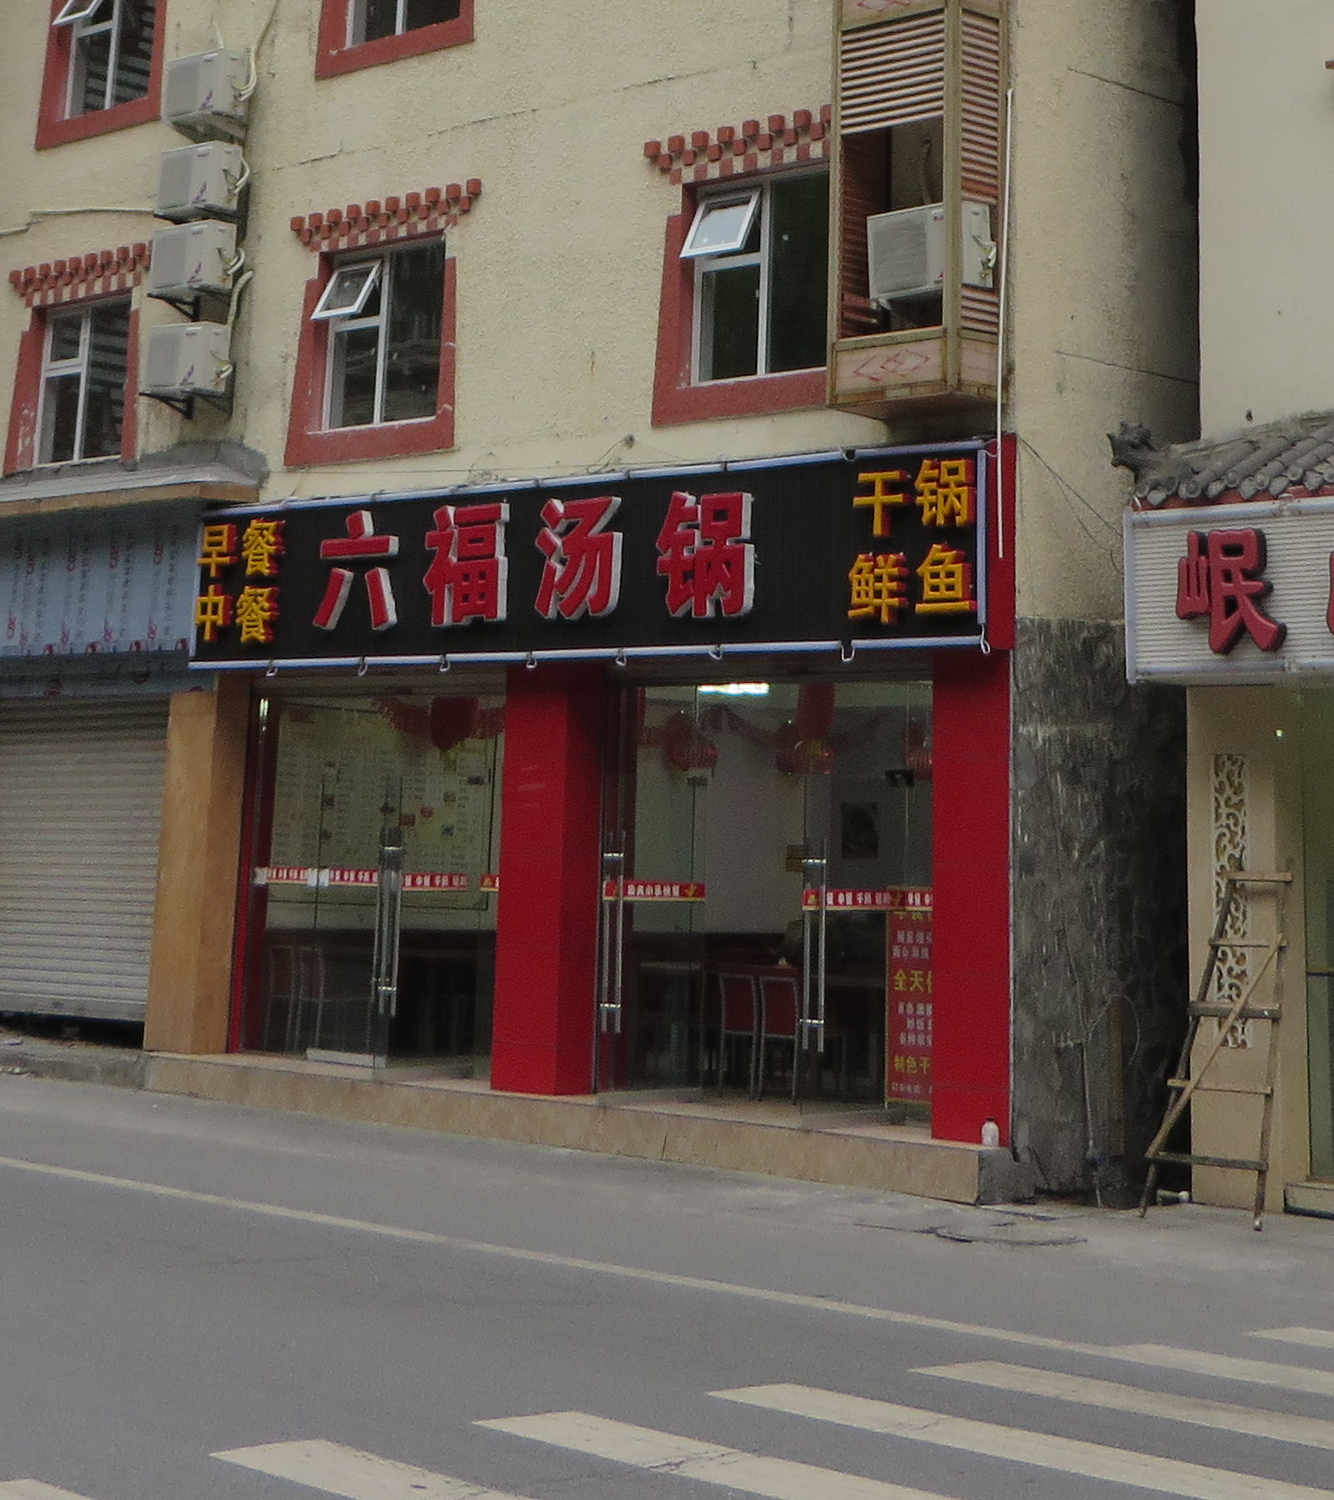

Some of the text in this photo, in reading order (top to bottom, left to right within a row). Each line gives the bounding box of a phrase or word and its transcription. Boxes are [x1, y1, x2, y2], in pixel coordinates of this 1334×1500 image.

[852, 457, 976, 538] 干锅
[196, 517, 285, 578] 早餐
[312, 490, 756, 631] 六福汤锅
[847, 543, 977, 626] 鲜鱼
[194, 584, 280, 645] 中餐
